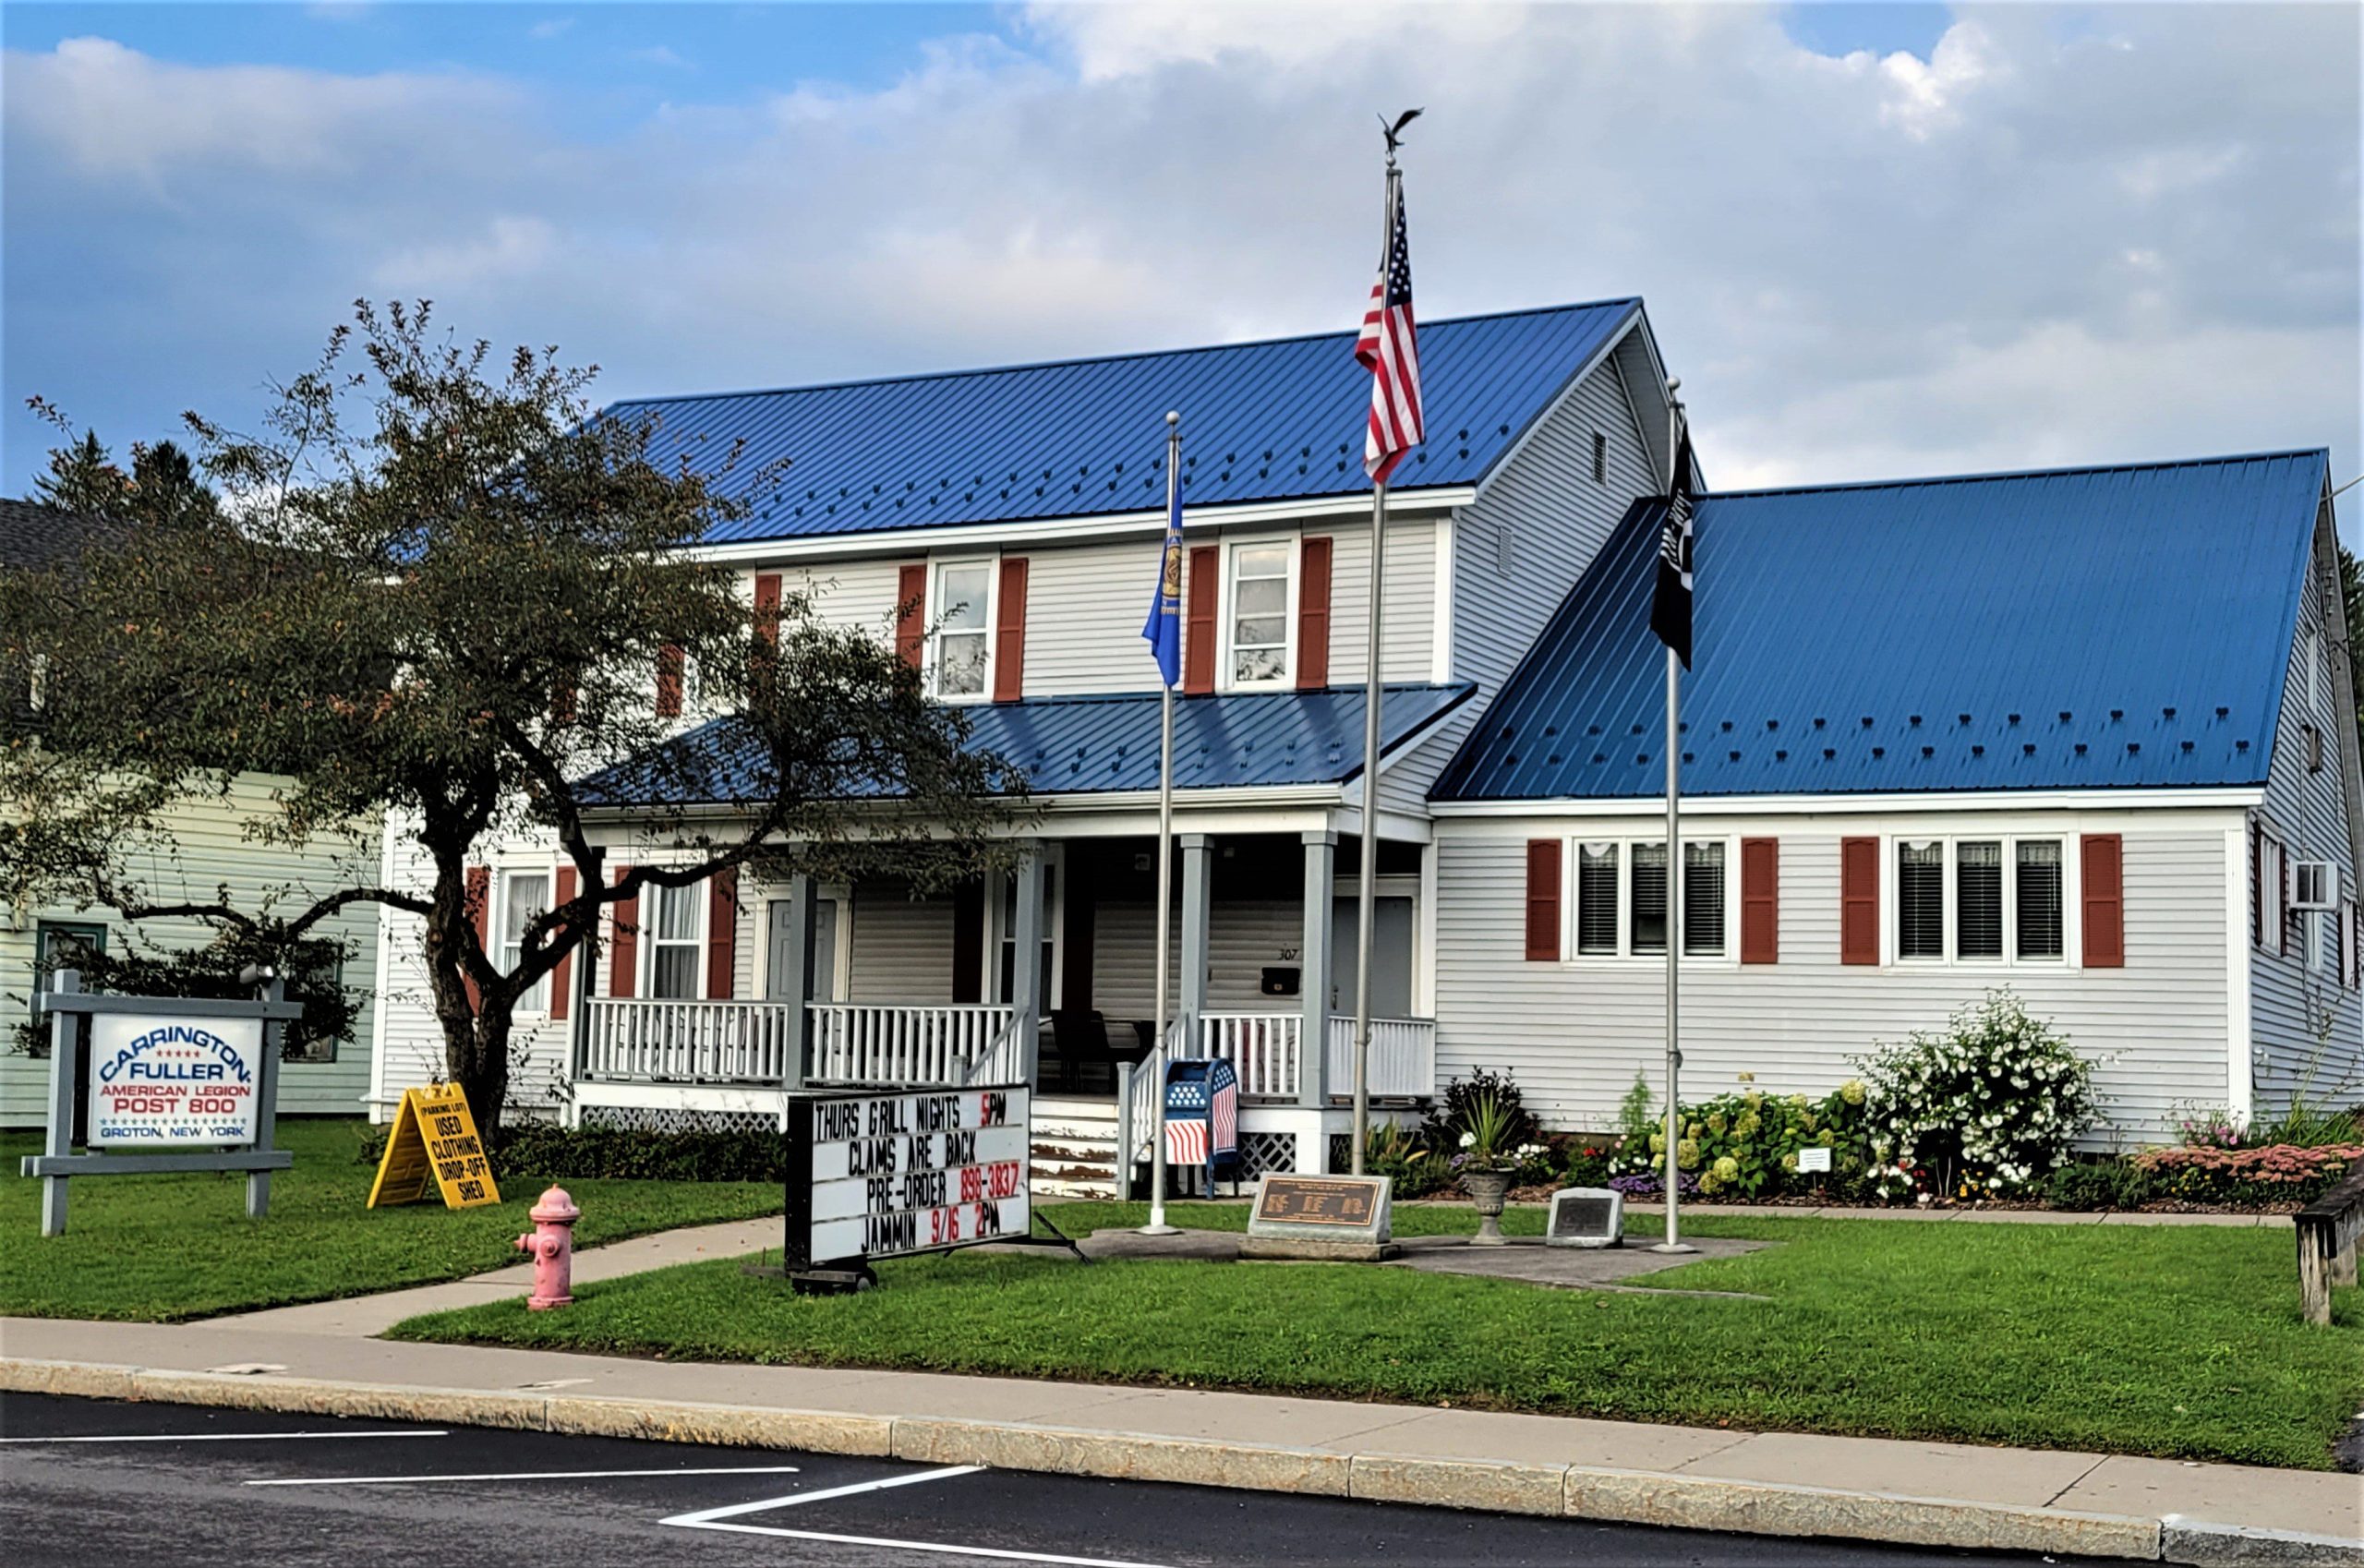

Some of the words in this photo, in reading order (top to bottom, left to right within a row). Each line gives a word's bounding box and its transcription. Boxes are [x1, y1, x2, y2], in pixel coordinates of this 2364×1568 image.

[1278, 948, 1298, 960] 307
[129, 1063, 223, 1080] FULLER
[100, 1085, 187, 1097] AMERICAN
[195, 1086, 250, 1097] LEGION
[114, 1098, 180, 1114] POST
[188, 1098, 236, 1114] 800
[421, 1104, 452, 1117] (PARKING
[451, 1102, 467, 1114] LOT)
[816, 1102, 860, 1140] THURS
[868, 1099, 908, 1136] GRILL
[916, 1095, 959, 1131] NIGHTS
[981, 1092, 1007, 1127] 5PM
[101, 1127, 164, 1139] GROTON,
[169, 1127, 202, 1137] NEW
[208, 1127, 245, 1137] YORK
[435, 1116, 463, 1137] USED
[431, 1135, 480, 1161] CLOTHING
[849, 1137, 896, 1176] CLAMS
[908, 1134, 933, 1169] ARE
[945, 1131, 977, 1167] BACK
[438, 1156, 488, 1181] DROP-OFF
[457, 1178, 485, 1201] SHED
[867, 1170, 947, 1214] PRE-ORDER
[960, 1162, 1019, 1202] 898-3837
[861, 1212, 916, 1254] JAMMIN
[931, 1205, 960, 1245] 9/16
[974, 1200, 1001, 1237] 2PM
